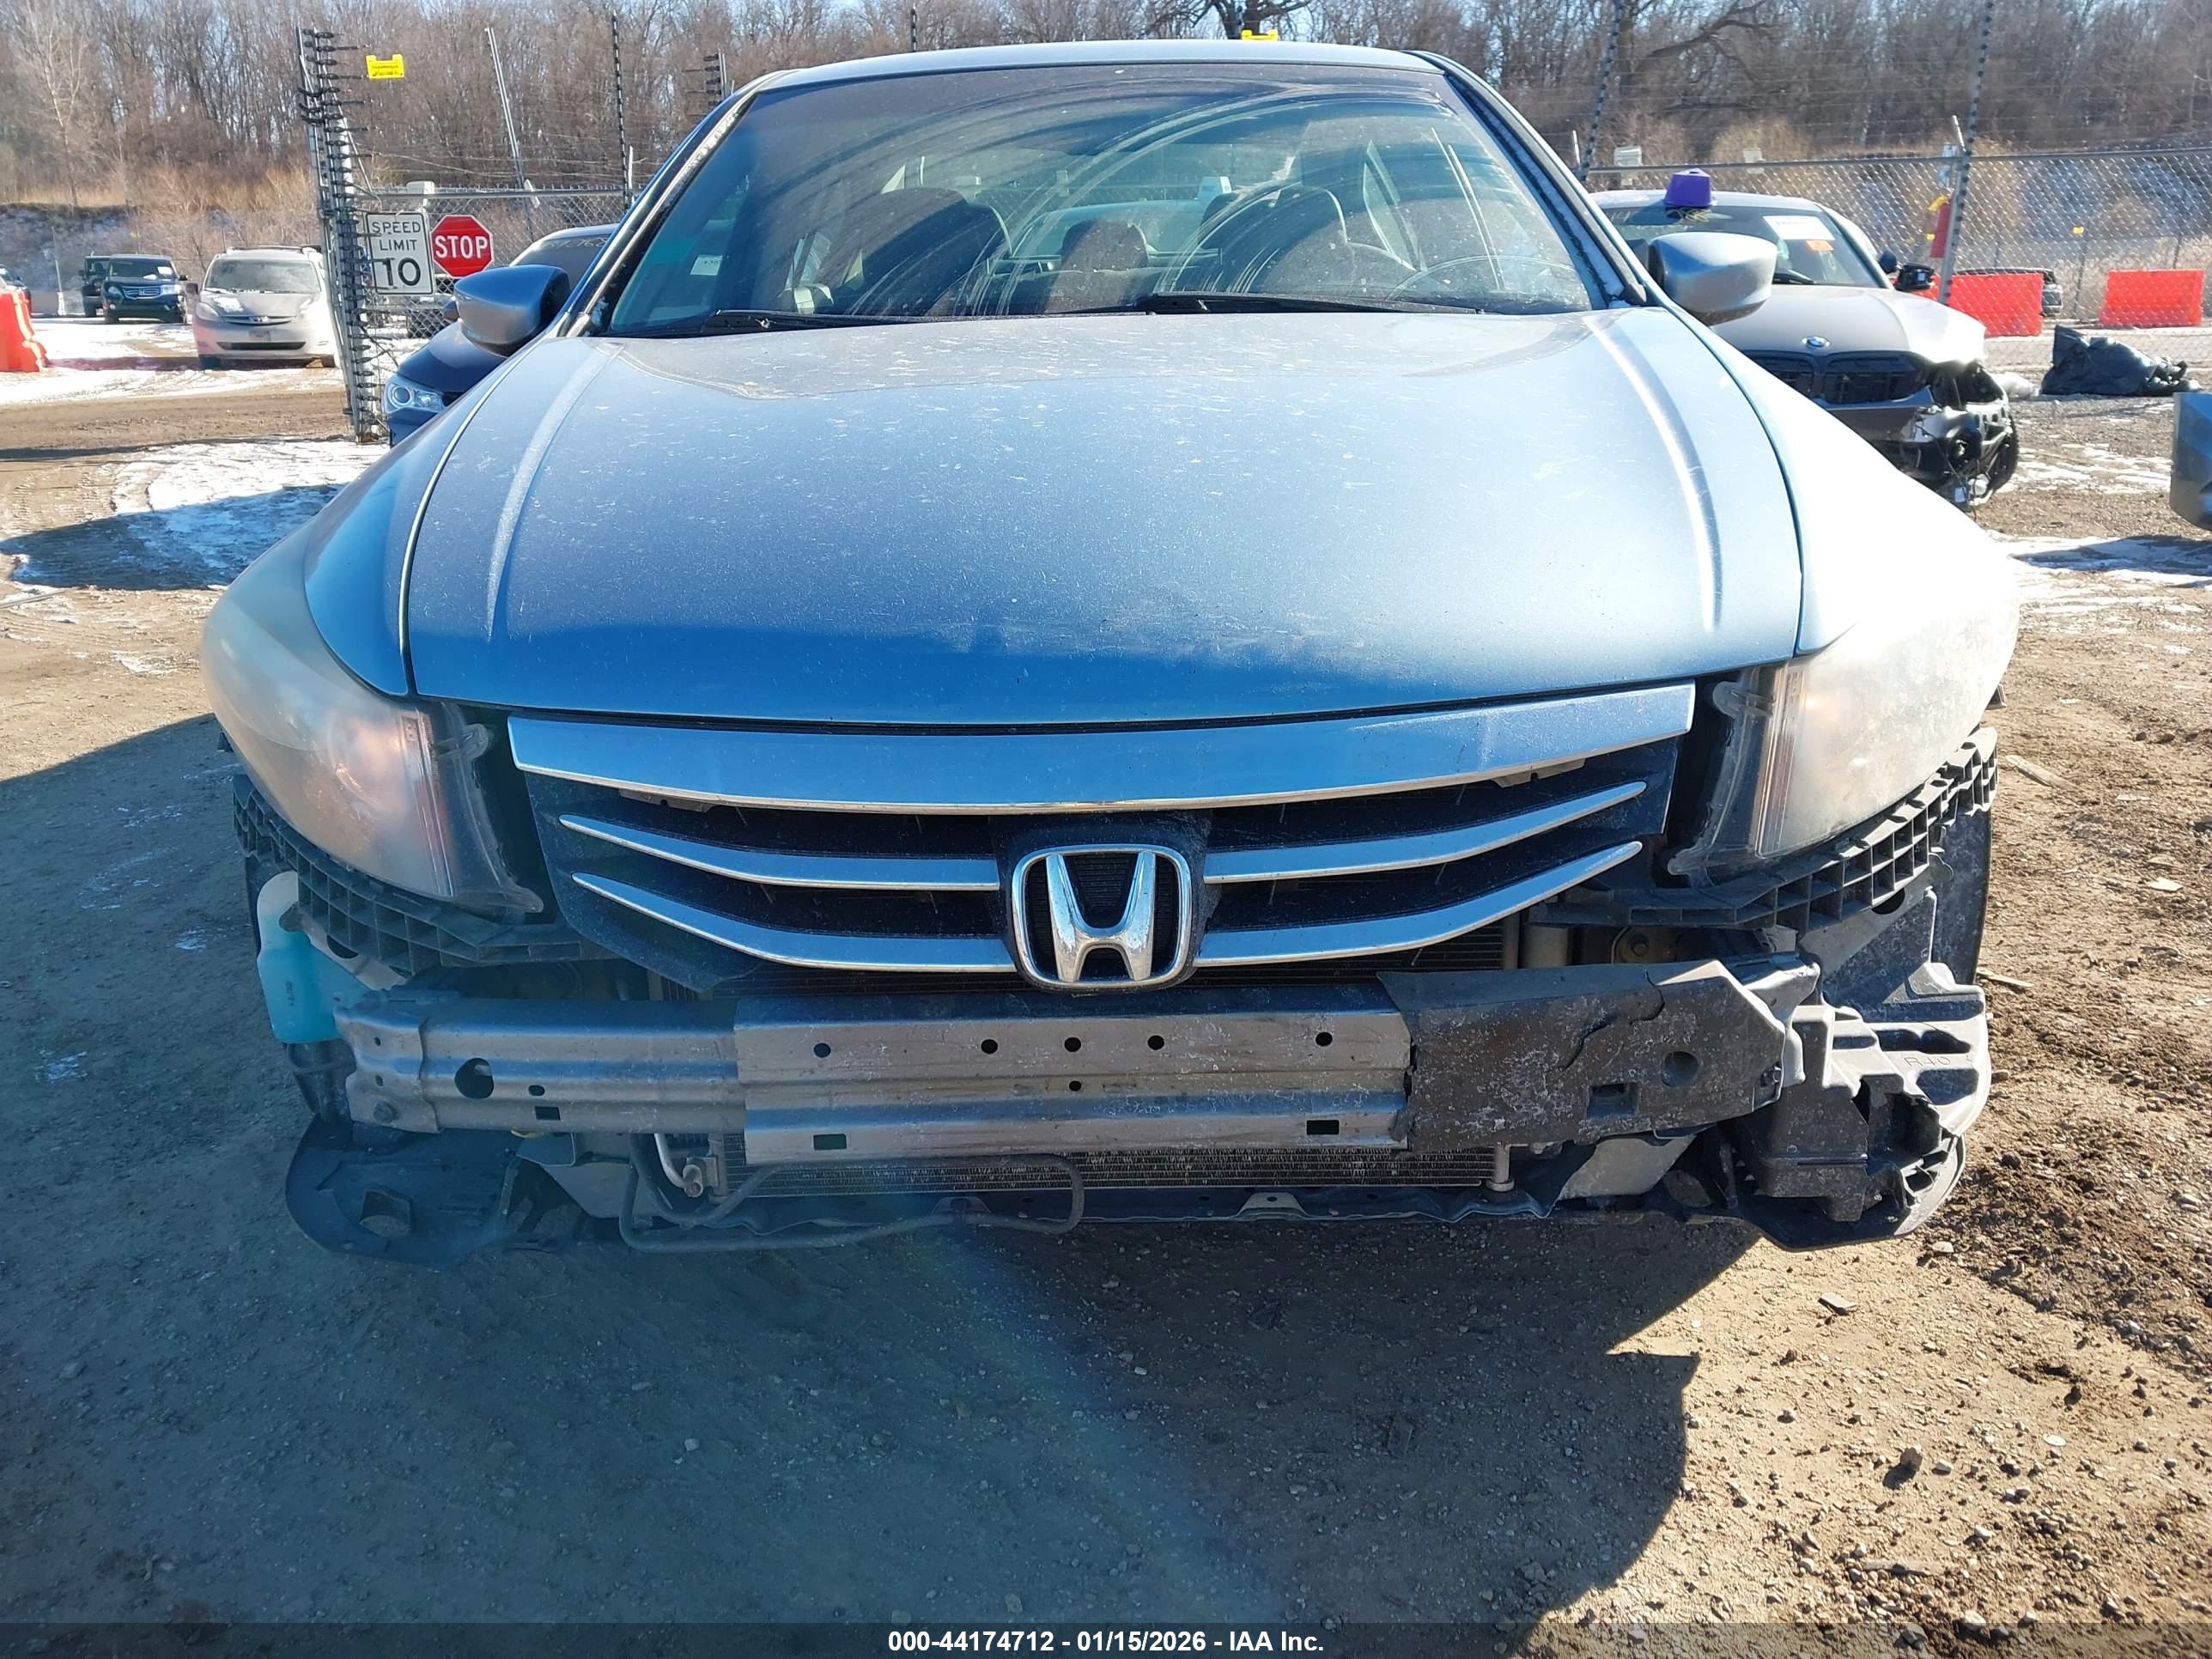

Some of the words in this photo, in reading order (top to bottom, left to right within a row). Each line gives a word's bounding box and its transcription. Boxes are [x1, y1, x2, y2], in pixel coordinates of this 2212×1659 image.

[372, 222, 421, 234] SPEED
[380, 239, 417, 251] LIMIT
[434, 234, 488, 258] STOP
[382, 258, 421, 286] 10
